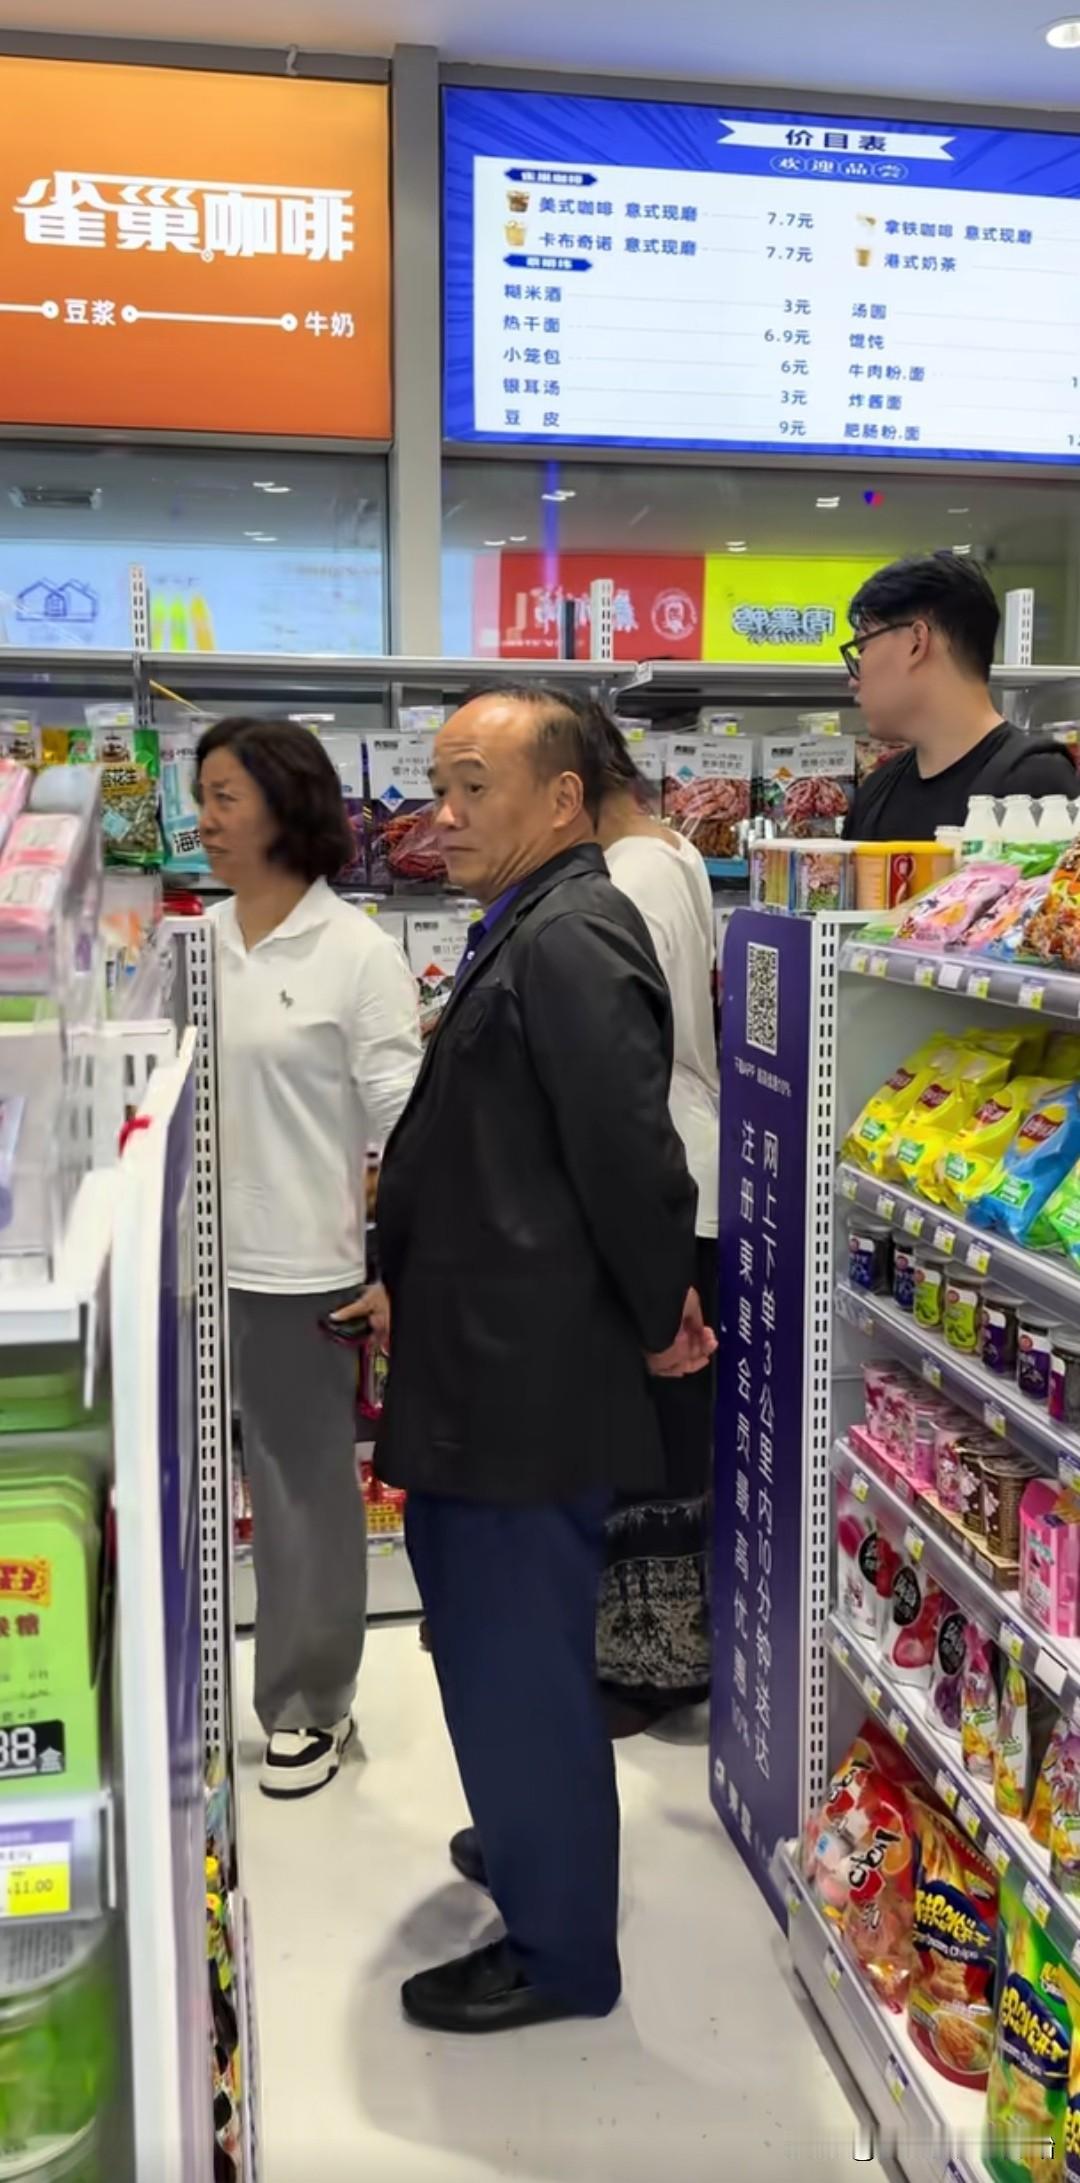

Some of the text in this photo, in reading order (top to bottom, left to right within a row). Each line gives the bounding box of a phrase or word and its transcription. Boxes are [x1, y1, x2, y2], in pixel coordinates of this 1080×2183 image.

[785, 129, 887, 152] 价目表
[12, 170, 355, 262] 雀巢咖啡
[538, 196, 815, 230] 美式咖啡 意式现磨 7.7元
[884, 219, 1033, 245] 拿铁咖啡 意式现磨
[539, 232, 814, 263] 卡布奇诺 意式现磨 7.7元
[884, 253, 957, 273] 港式奶茶
[503, 283, 812, 316] 糊米酒 3元
[851, 303, 887, 321] 汤圆
[64, 298, 355, 338] 豆浆 牛奶
[503, 315, 812, 346] 热干面 6.9元
[503, 347, 810, 376] 小笼包 6元
[503, 377, 809, 406] 银耳汤 3元
[848, 393, 902, 411] 炸酱面
[779, 420, 807, 436] 9元
[754, 1129, 780, 1780] 网上下单3公里内10分钟送达
